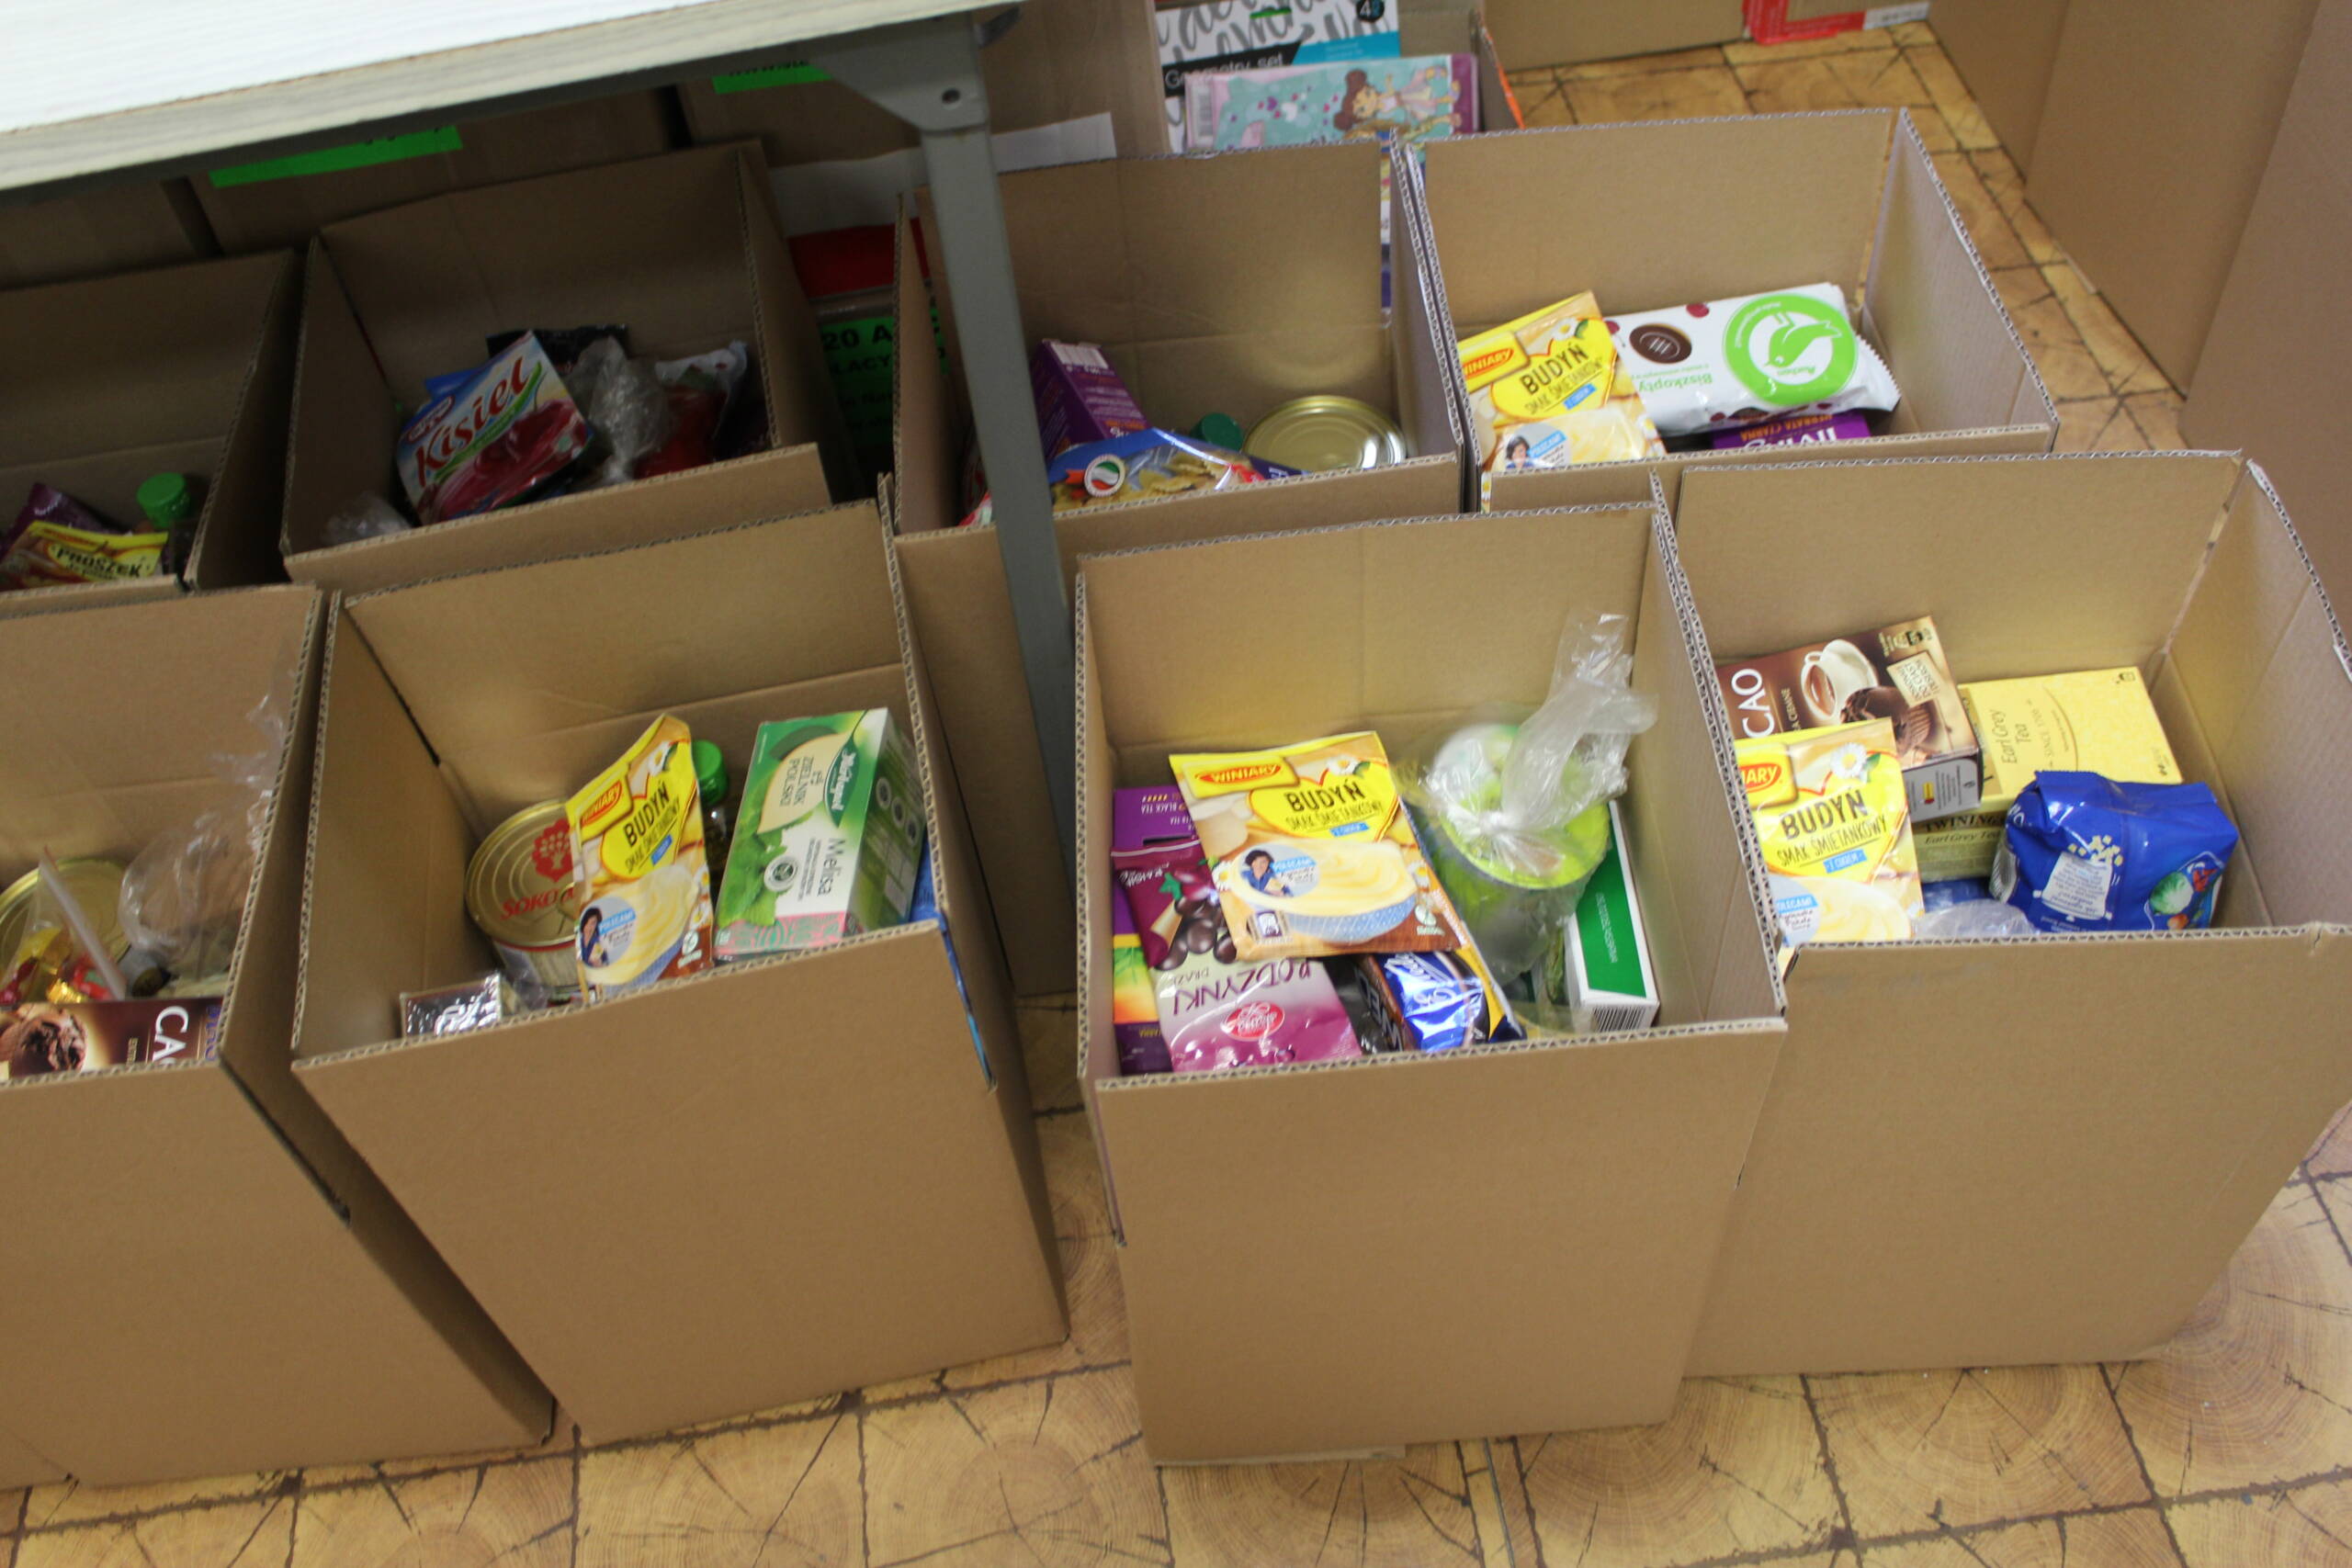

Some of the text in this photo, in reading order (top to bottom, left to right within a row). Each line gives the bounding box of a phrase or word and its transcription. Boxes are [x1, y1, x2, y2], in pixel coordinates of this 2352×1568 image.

[1520, 342, 1589, 395] BUDYŃ
[1638, 374, 1713, 392] Biszkopty
[416, 356, 529, 487] Kisiel
[1731, 669, 1775, 738] CAO
[2000, 737, 2018, 764] Earl
[2015, 723, 2031, 744] Tea
[1212, 764, 1277, 783] WINIARY
[1155, 802, 1178, 813] BLACK
[1284, 778, 1365, 812] BUDYŃ
[623, 780, 670, 847] BUDYŃ
[1777, 816, 1887, 866] SMAK ŚMIETANKOWY
[818, 838, 846, 896] Melisa
[501, 887, 574, 919] SOKO
